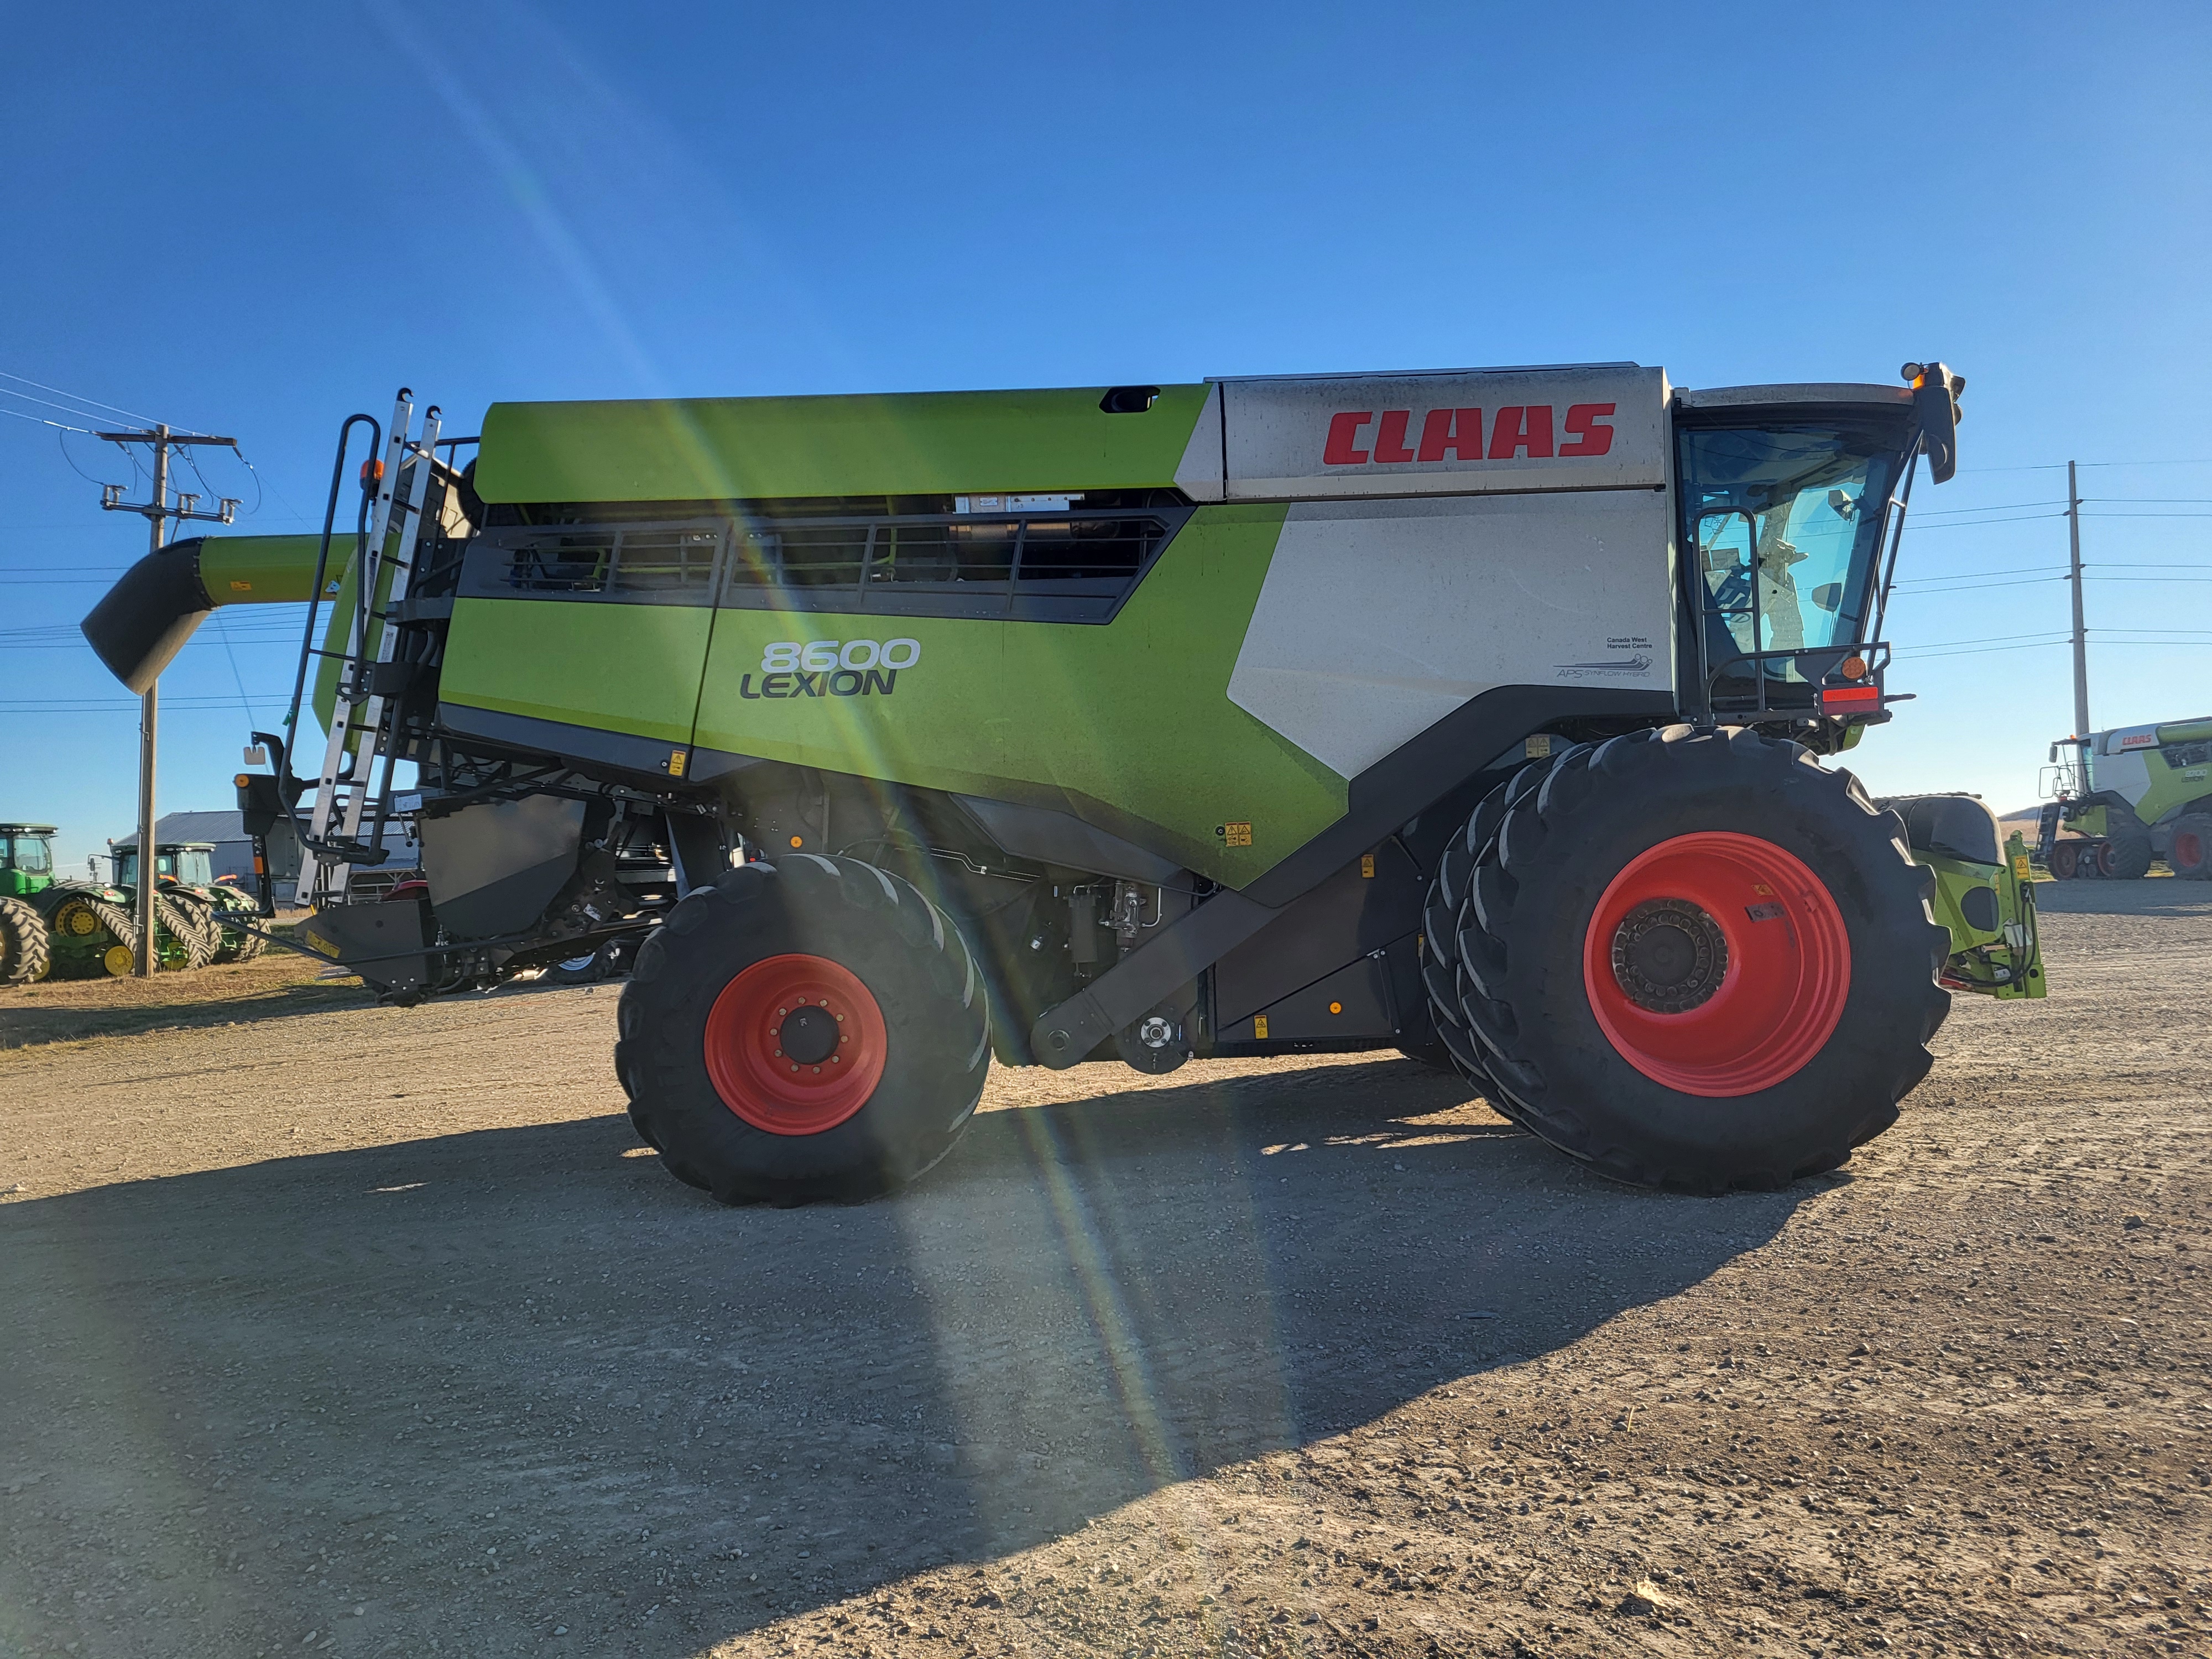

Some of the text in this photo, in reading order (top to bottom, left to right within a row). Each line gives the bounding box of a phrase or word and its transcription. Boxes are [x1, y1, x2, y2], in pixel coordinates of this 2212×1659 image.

[1323, 403, 1616, 465] CLAAS
[761, 638, 921, 673] 8600
[740, 669, 897, 699] LEXION
[1556, 669, 1584, 678] APS
[2122, 734, 2152, 745] CLAAS
